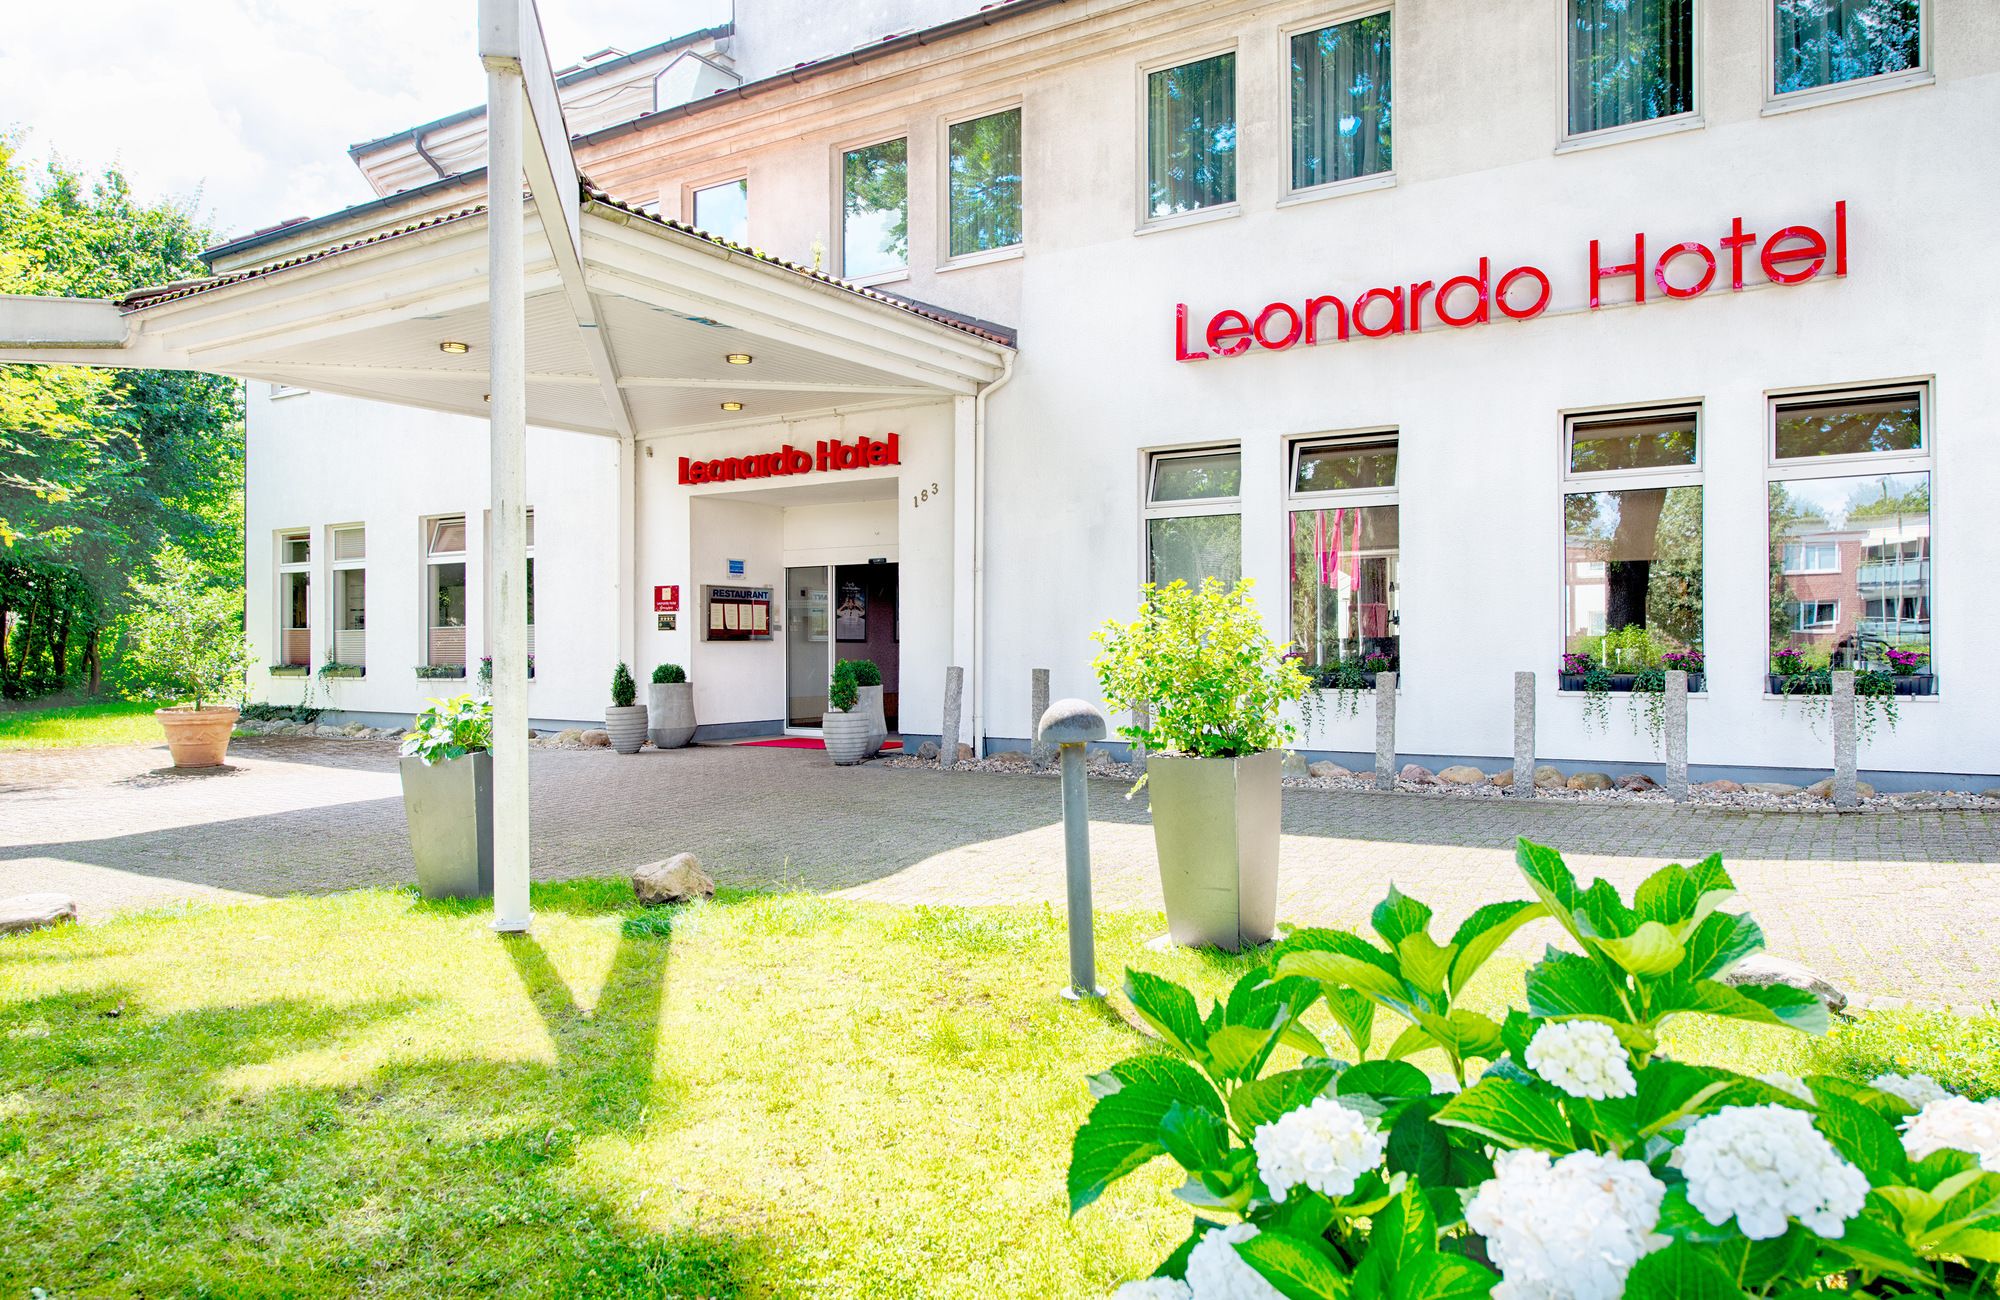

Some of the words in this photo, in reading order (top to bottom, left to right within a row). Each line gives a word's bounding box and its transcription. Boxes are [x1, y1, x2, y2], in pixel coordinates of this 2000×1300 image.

[1176, 257, 1552, 362] Leonardo
[1590, 201, 1848, 311] Hotel
[678, 445, 813, 485] Leonardo
[816, 433, 900, 472] Hotel
[913, 482, 939, 508] 183
[712, 588, 769, 599] RESTAURANT
